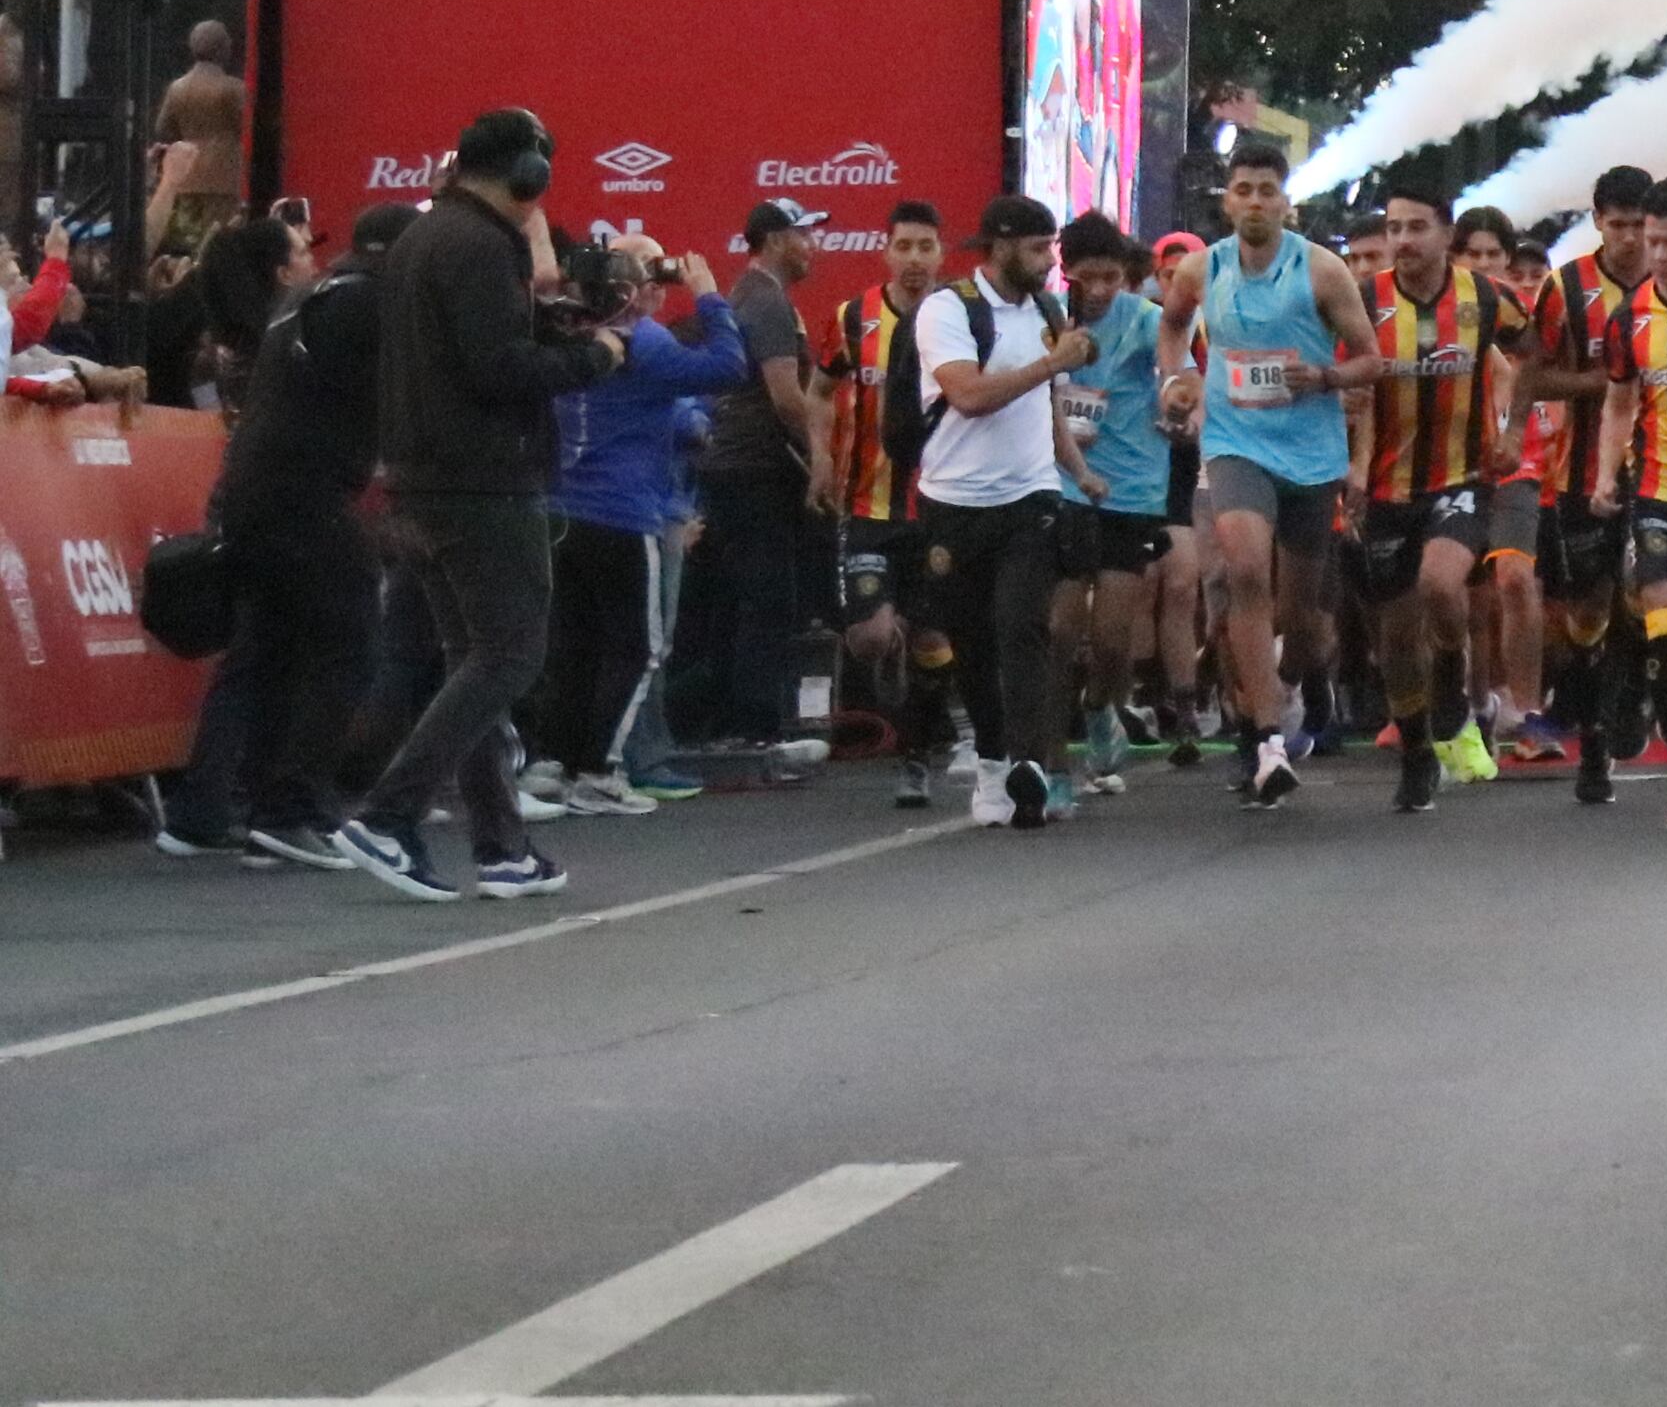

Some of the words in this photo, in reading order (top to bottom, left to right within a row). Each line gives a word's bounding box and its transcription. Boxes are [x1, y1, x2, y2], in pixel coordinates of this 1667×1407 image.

[756, 157, 901, 187] Electrolit
[601, 176, 666, 193] umbro
[1250, 366, 1283, 386] 818
